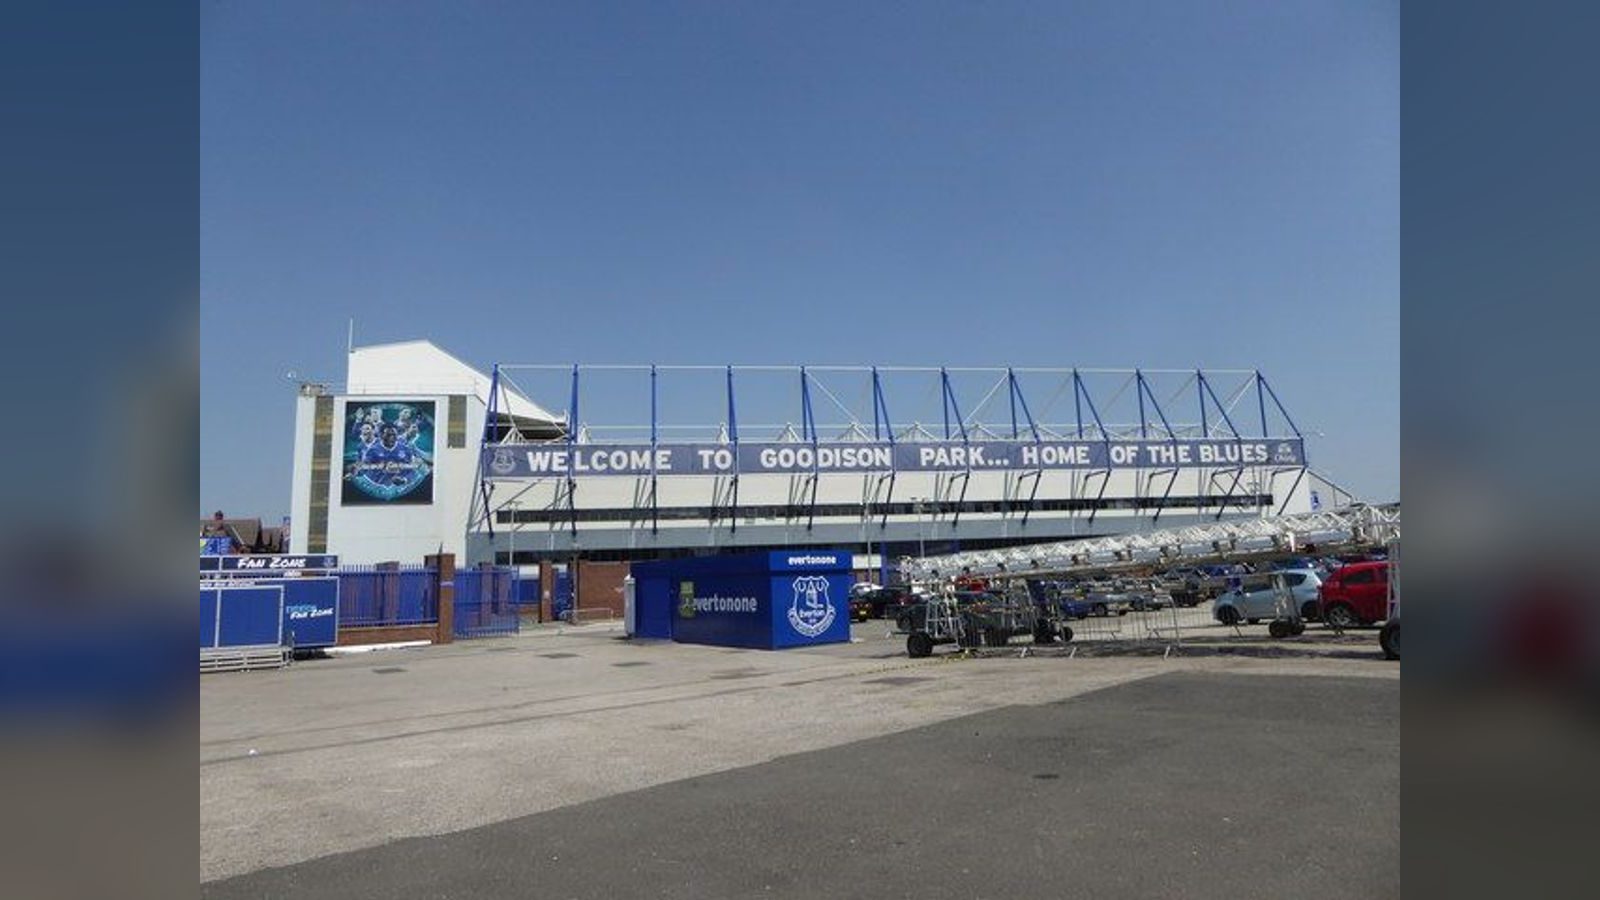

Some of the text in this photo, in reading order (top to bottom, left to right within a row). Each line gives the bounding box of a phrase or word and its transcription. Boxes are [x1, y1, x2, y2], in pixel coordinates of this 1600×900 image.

[526, 450, 672, 472] WELCOME
[698, 449, 733, 469] TO
[760, 448, 892, 468] GOODISON
[920, 447, 1009, 467] PARK...
[1022, 445, 1090, 465] HOME
[1110, 445, 1139, 463] OF
[1149, 445, 1192, 463] THE
[1200, 444, 1268, 462] BLUES
[238, 557, 306, 568] FAN ZONE
[788, 556, 836, 565] evertonone
